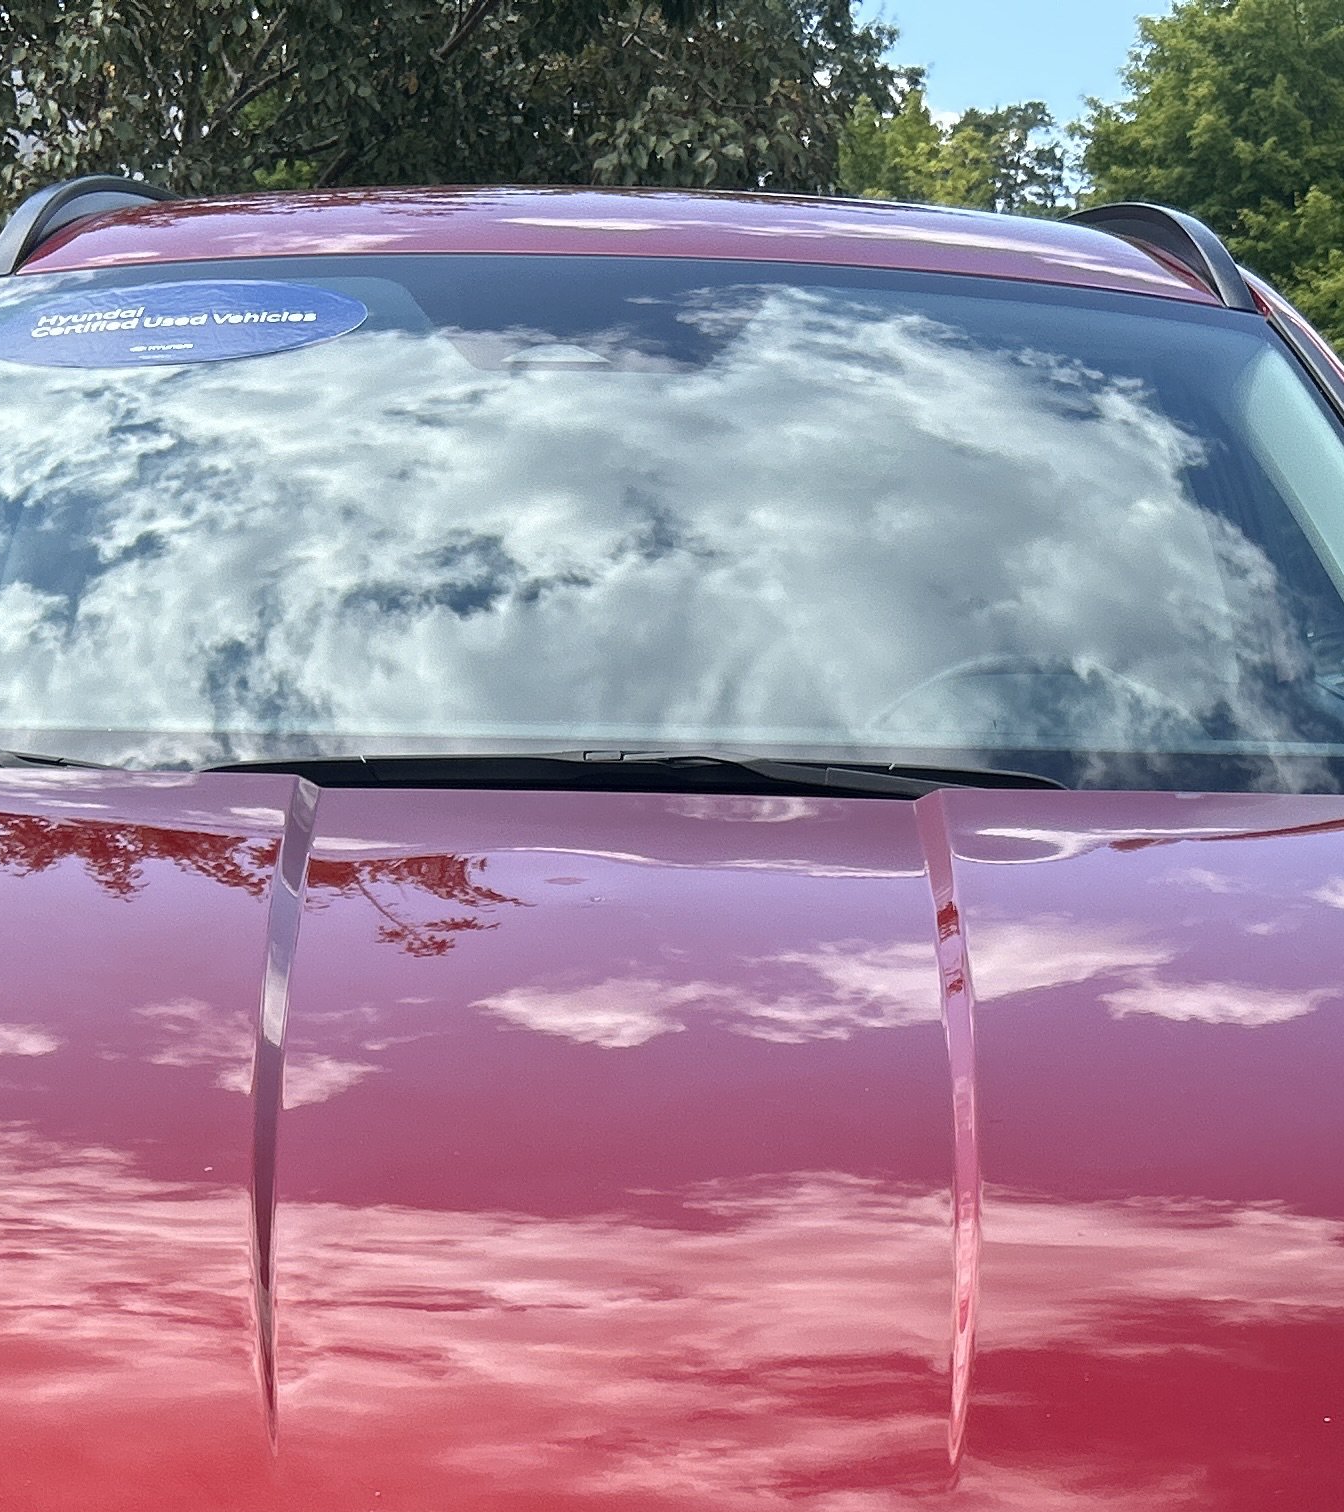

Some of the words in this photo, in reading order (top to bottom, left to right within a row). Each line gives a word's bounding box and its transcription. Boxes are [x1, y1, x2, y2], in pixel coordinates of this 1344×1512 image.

[31, 317, 140, 338] Certified
[143, 313, 207, 328] Used
[213, 311, 317, 325] Vehicles
[37, 306, 146, 327] Hyundai
